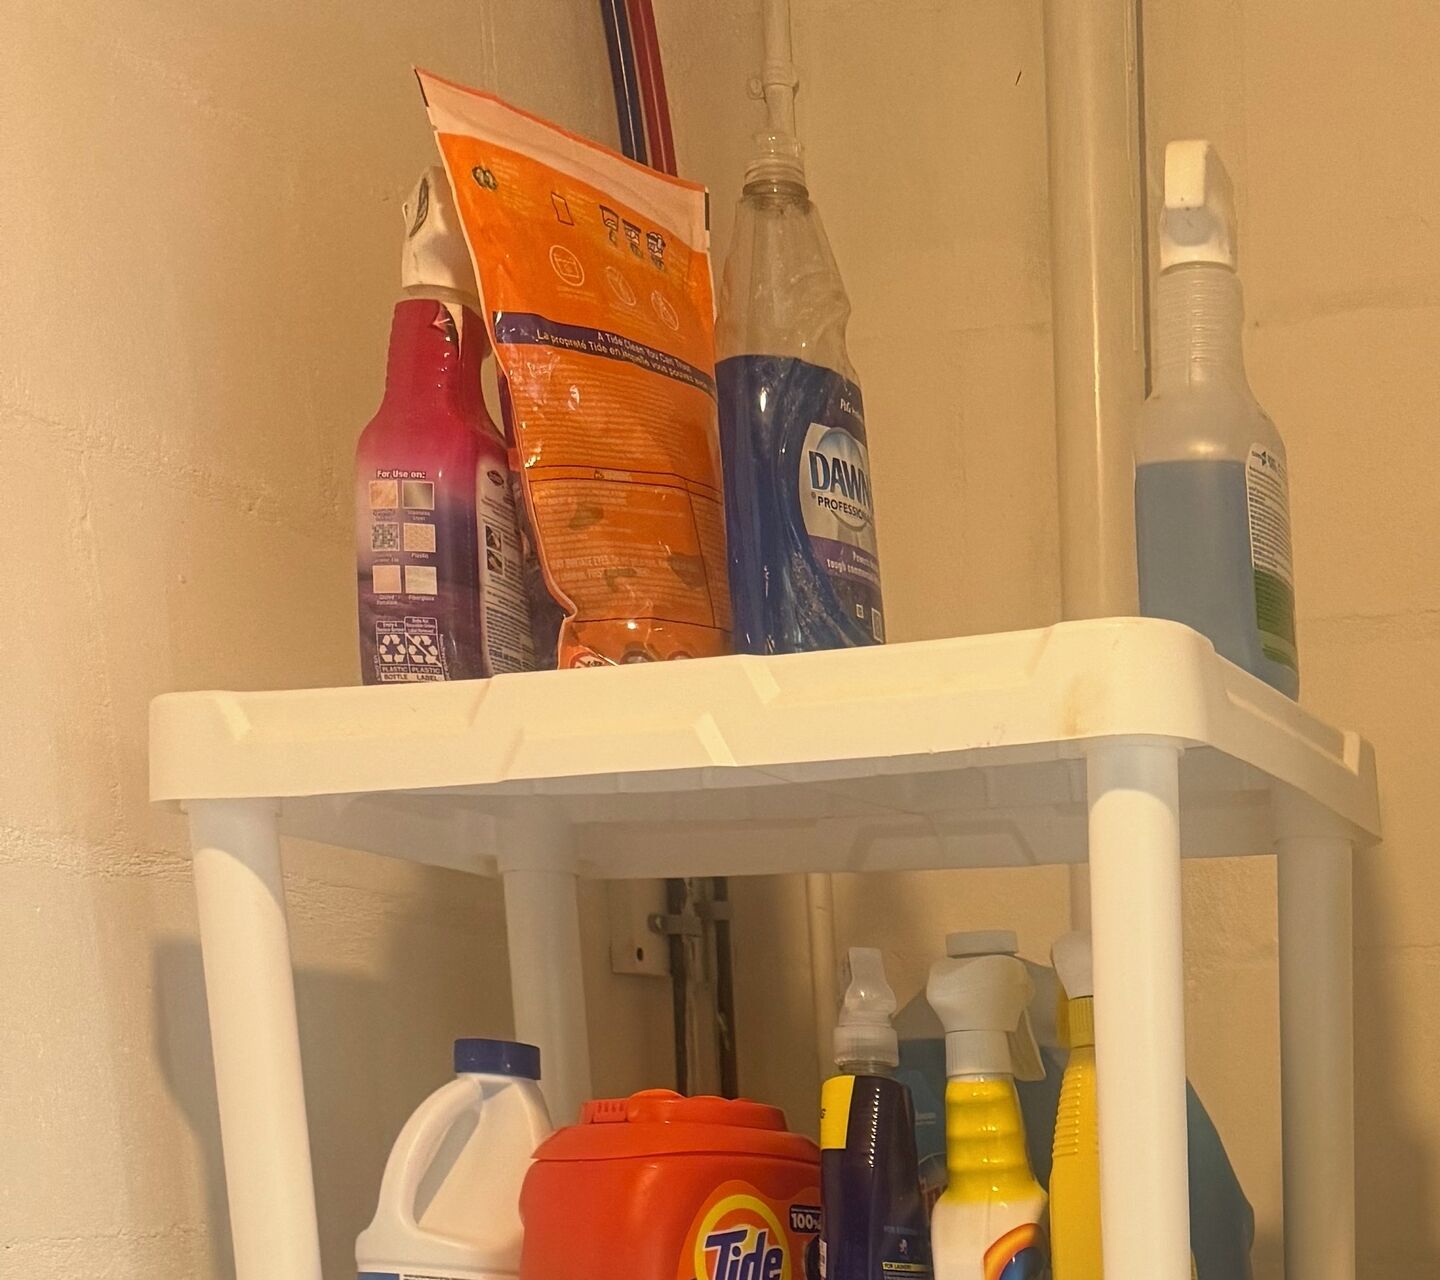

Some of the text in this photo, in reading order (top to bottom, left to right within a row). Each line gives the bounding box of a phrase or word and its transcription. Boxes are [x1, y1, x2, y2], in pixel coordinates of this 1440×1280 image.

[377, 470, 426, 479] For Use on:
[808, 451, 872, 507] DAWN
